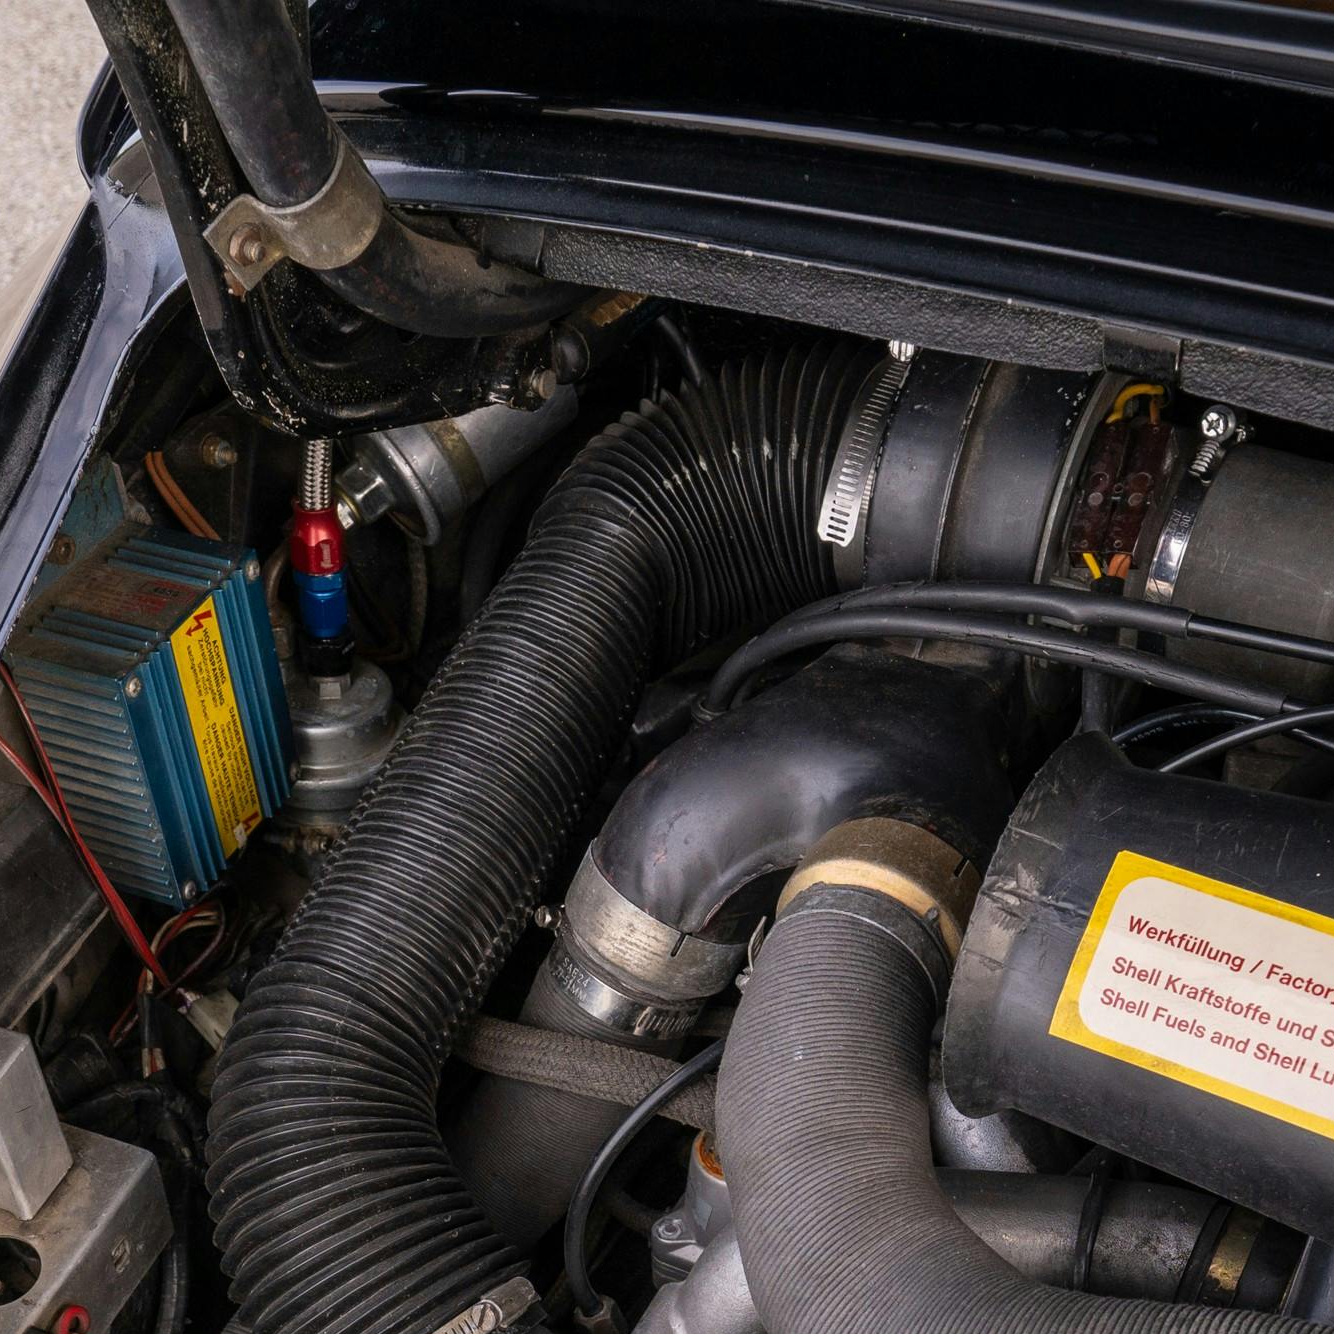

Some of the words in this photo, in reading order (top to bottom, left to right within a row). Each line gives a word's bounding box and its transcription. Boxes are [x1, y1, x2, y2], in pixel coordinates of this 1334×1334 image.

[203, 628, 225, 706] HOCHSPANNUNG
[212, 639, 227, 685] ACHTUNG
[211, 722, 224, 759] DANGER
[221, 760, 232, 790] HAUTE
[229, 706, 242, 744] DANGER
[238, 745, 248, 769] HIGH
[244, 769, 257, 806] VOLTAGE
[1128, 915, 1246, 972] Werkfüllung
[1248, 959, 1264, 974] /
[1100, 987, 1150, 1019] Shell
[1152, 1006, 1208, 1039] Fuels
[1210, 1028, 1251, 1054] and
[1253, 1042, 1307, 1075] Shell
[1111, 956, 1163, 986] Shell
[1164, 973, 1272, 1025] Kraftstoffe
[1275, 1016, 1318, 1041] und
